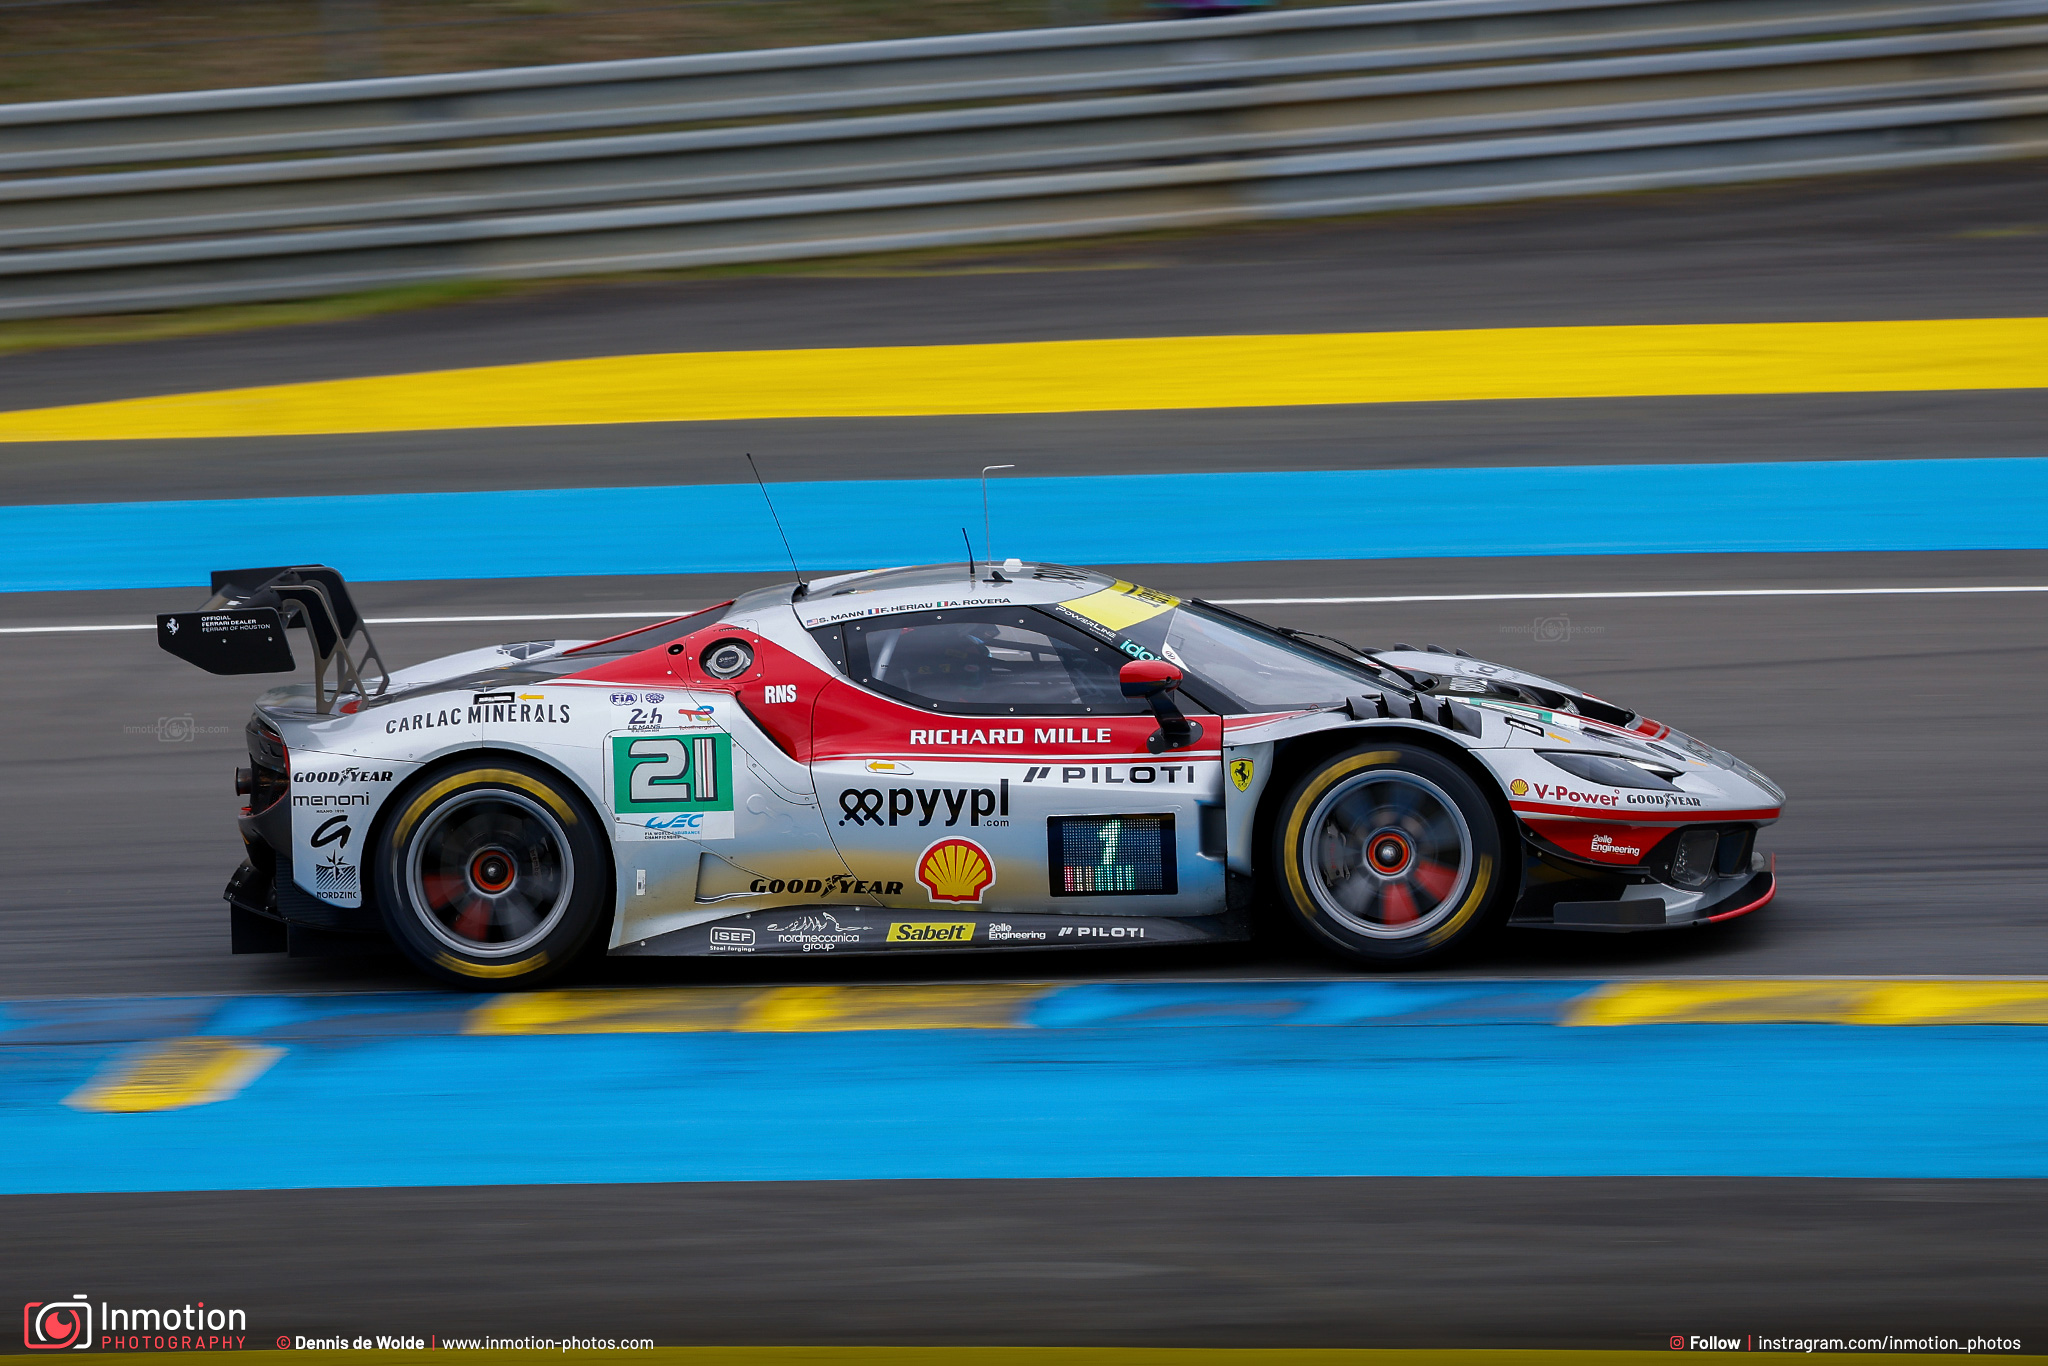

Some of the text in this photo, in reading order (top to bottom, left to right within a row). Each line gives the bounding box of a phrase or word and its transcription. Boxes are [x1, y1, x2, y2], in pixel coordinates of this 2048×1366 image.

[831, 610, 864, 620] MANN
[891, 602, 933, 612] HERIAU
[962, 597, 1011, 606] ROVERA
[764, 684, 797, 704] RNS
[385, 703, 570, 734] CARLAC MINERALS
[910, 727, 1111, 745] RICHARD MILLE
[293, 769, 394, 784] GOODYEAR
[628, 737, 719, 803] 21
[1062, 765, 1195, 784] PILOTI
[293, 791, 370, 806] menoni
[890, 778, 1010, 827] pyypl
[1533, 782, 1702, 807] V-Power GOODYEAR
[645, 813, 704, 829] WEC
[1097, 819, 1121, 865] 1
[1592, 834, 1613, 843] 2elle
[1590, 842, 1640, 856] Engineering
[749, 876, 904, 897] GOODYEAR
[316, 891, 357, 899] NORDZINC
[896, 924, 967, 940] Sabelt
[989, 923, 1012, 932] 2elle
[1078, 927, 1145, 938] PILOTI
[714, 931, 752, 942] ISEF
[778, 933, 860, 943] nordmeccanica
[989, 931, 1046, 941] Engineering
[802, 943, 835, 952] group
